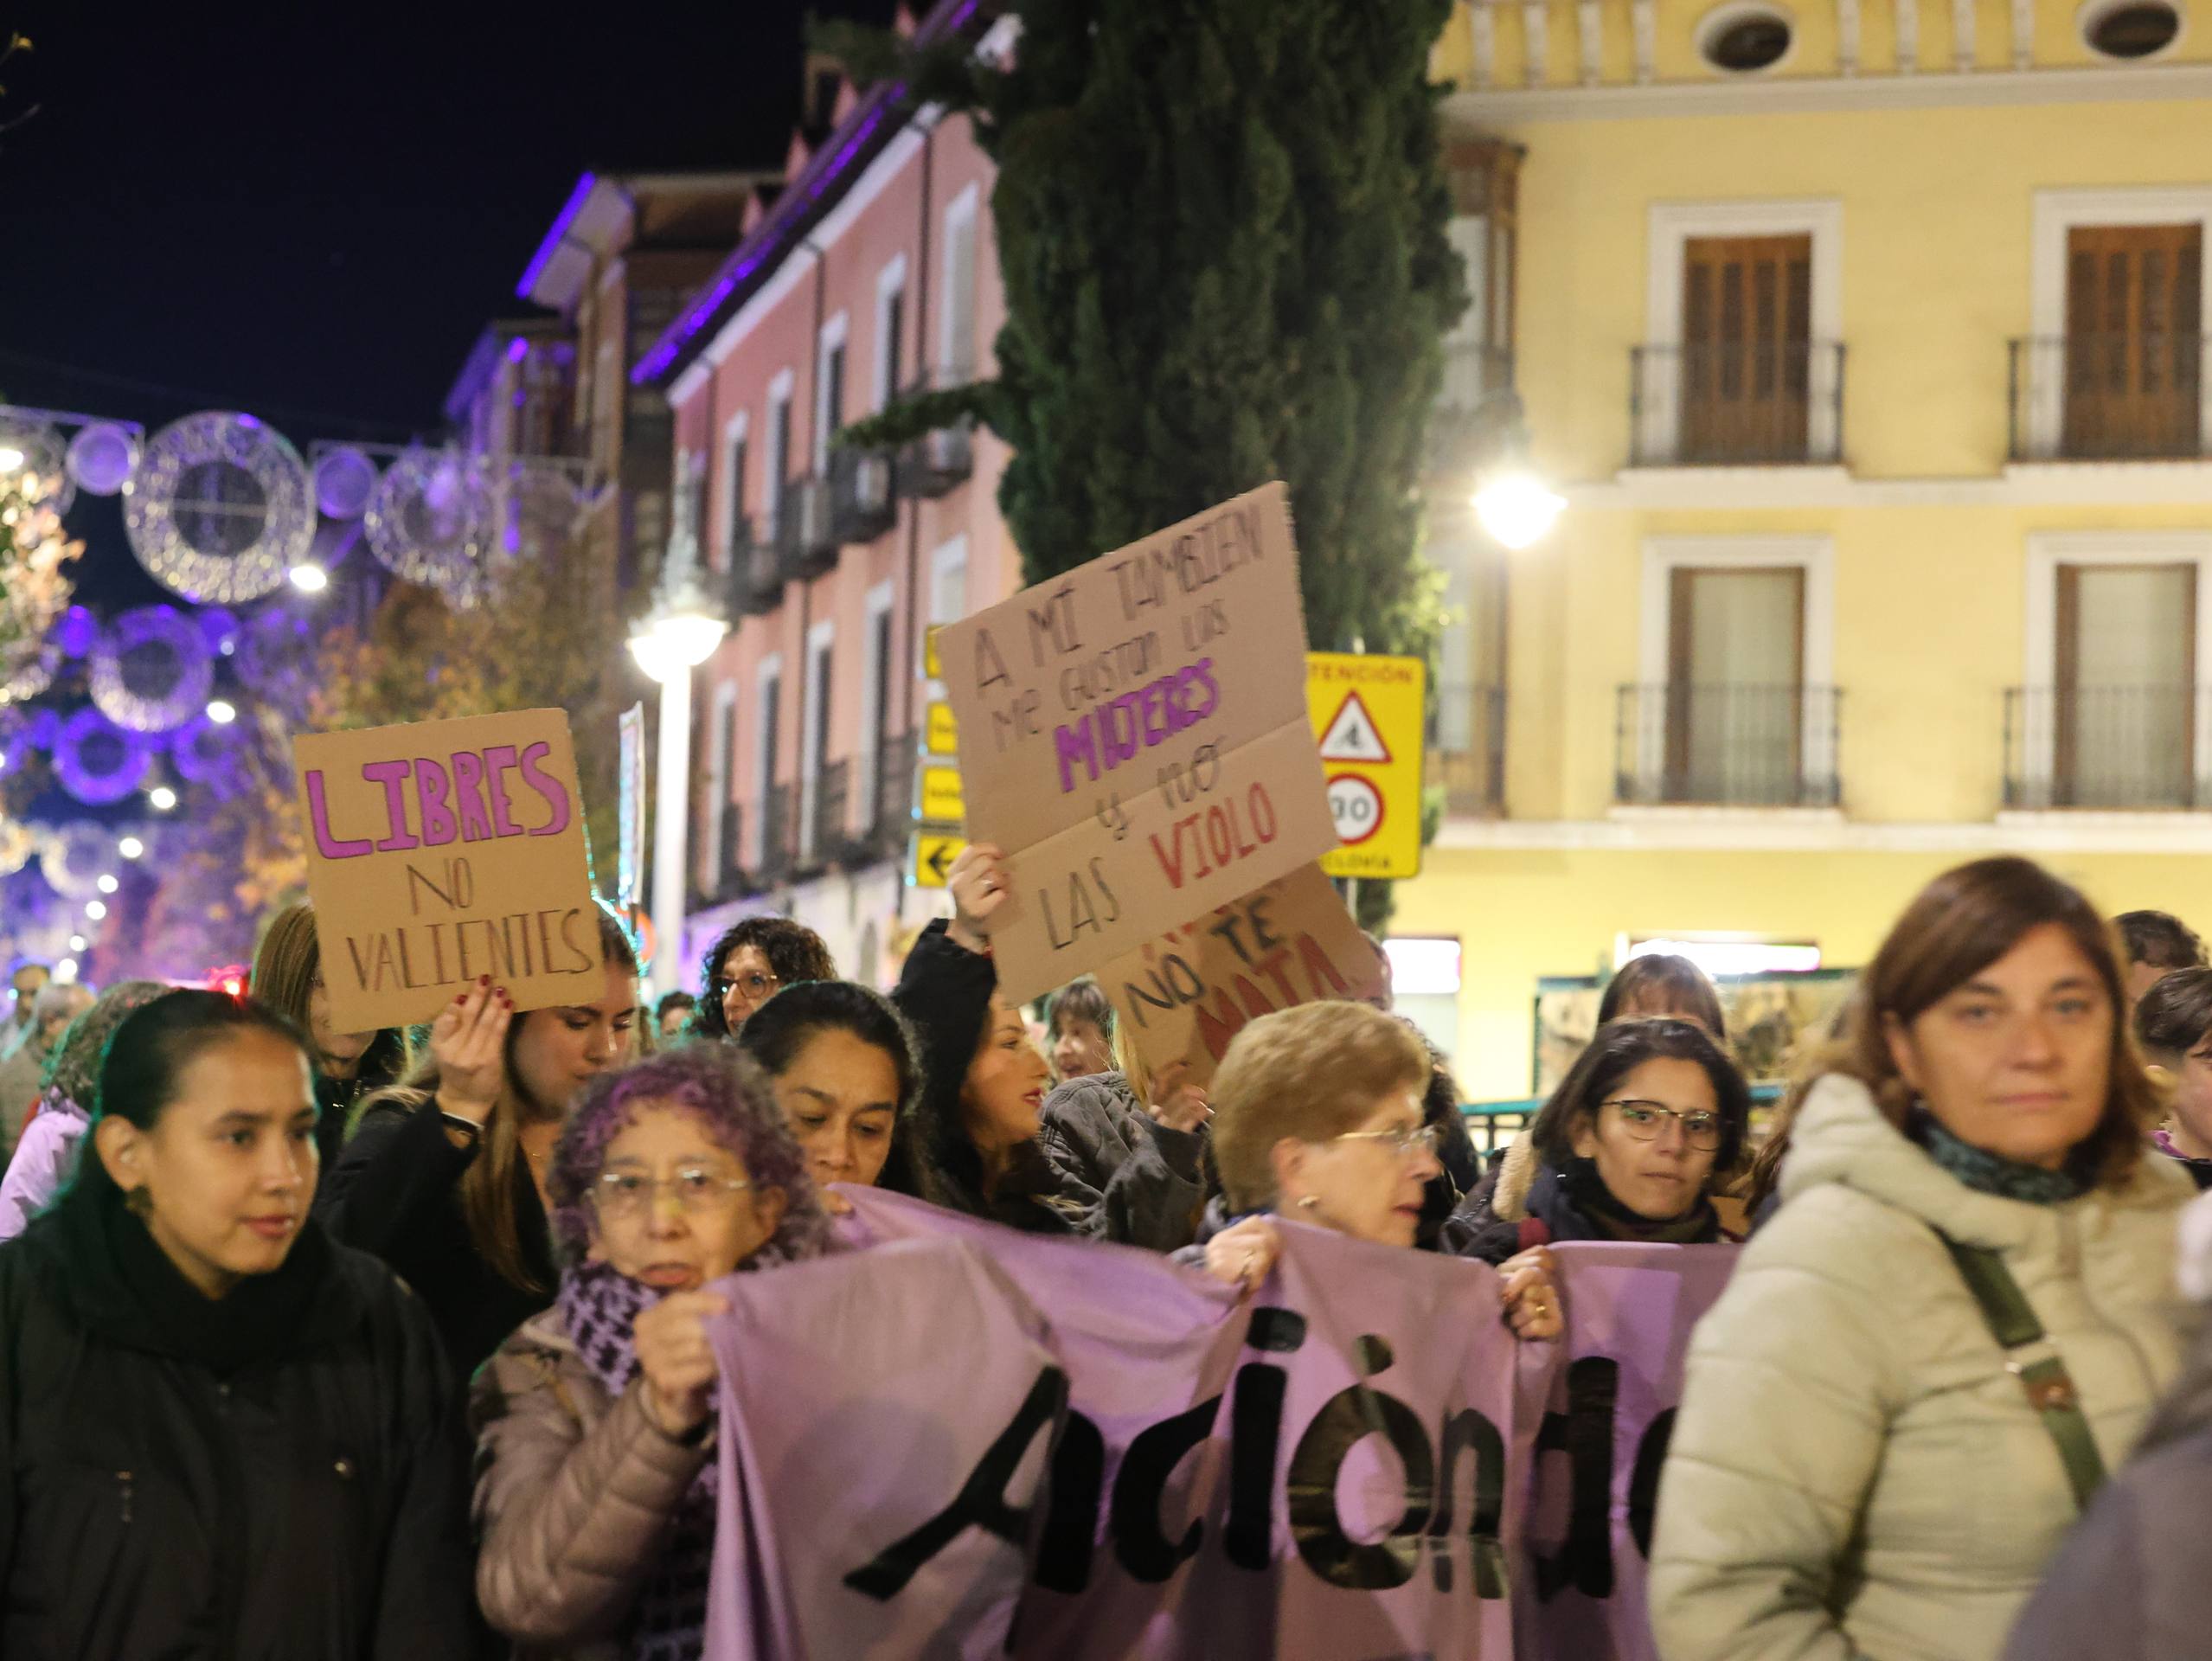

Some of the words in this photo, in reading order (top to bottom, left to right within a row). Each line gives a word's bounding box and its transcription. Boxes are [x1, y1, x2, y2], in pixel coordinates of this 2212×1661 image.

[972, 627, 1013, 700] A
[305, 741, 571, 860] LIBRES
[407, 856, 474, 916] NO
[1037, 856, 1122, 951] LAS
[1149, 781, 1278, 889] VIOLO
[346, 907, 593, 992] VALIENTES
[1125, 952, 1206, 1029] NO
[1209, 894, 1282, 972] TE
